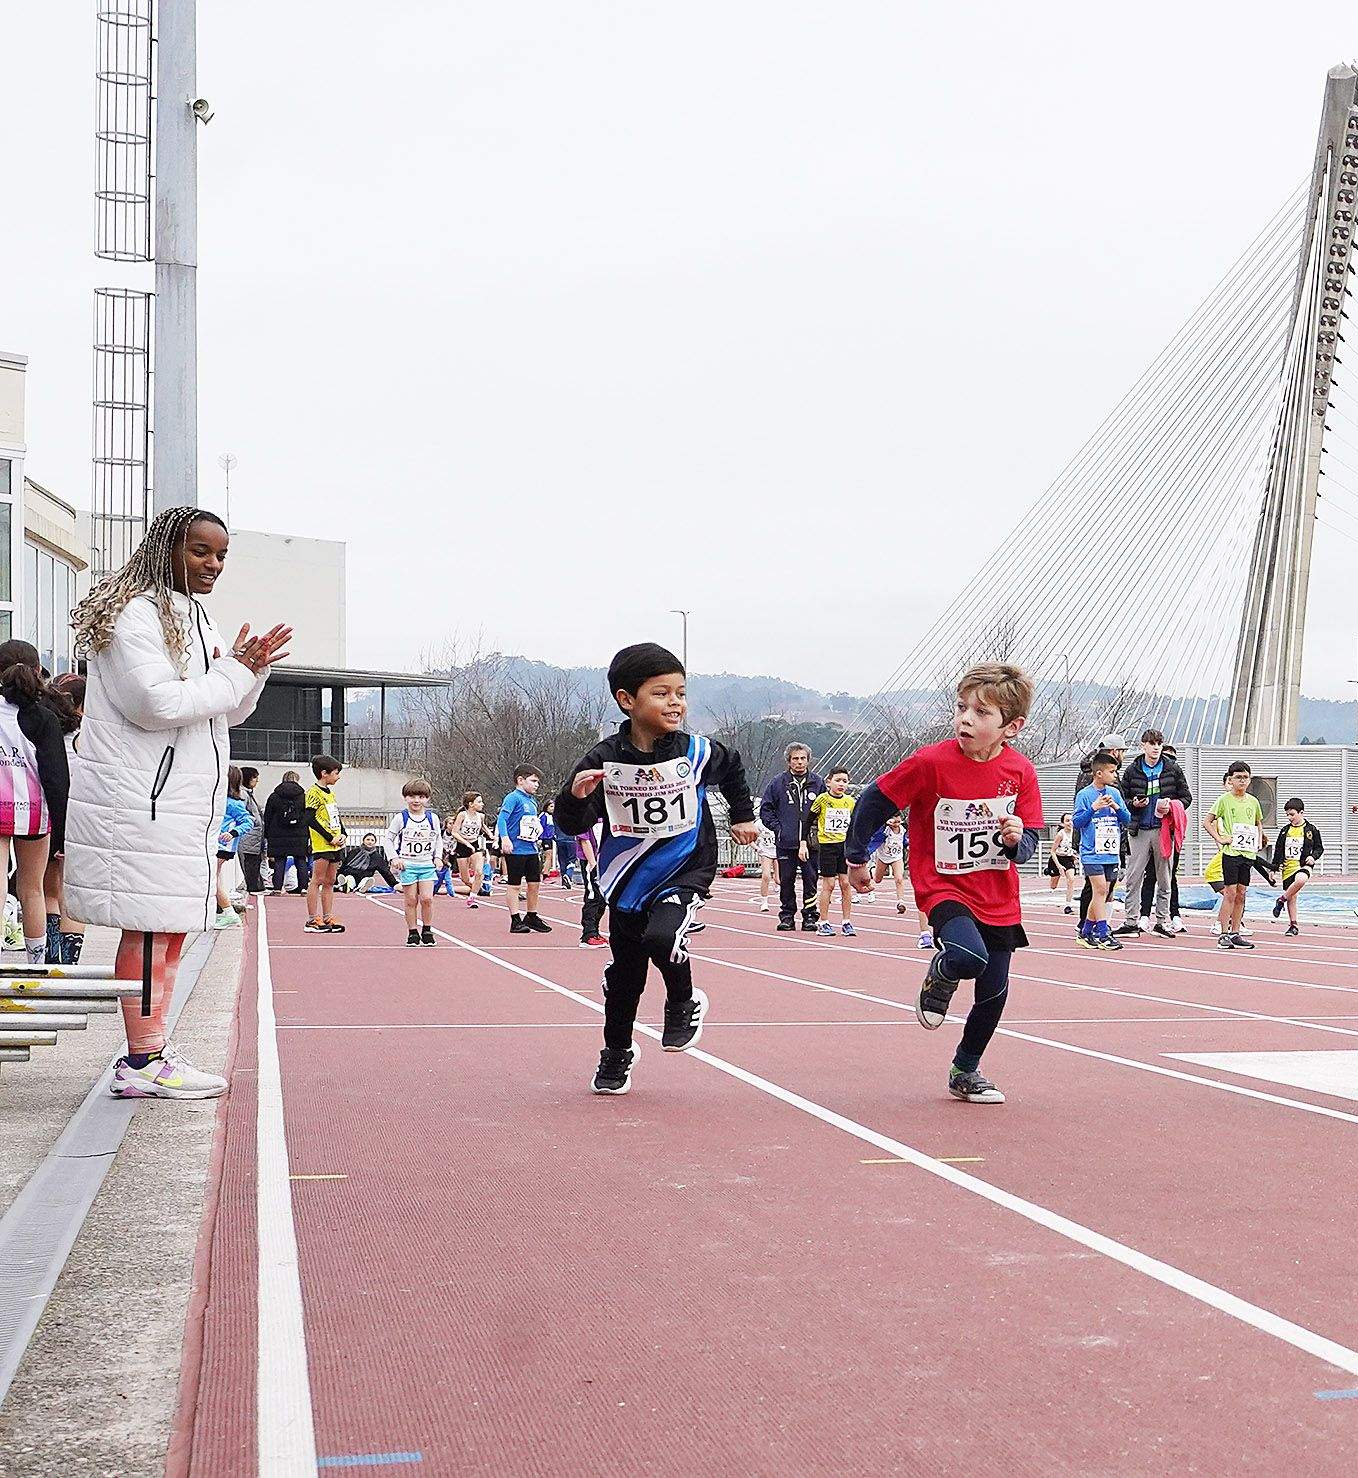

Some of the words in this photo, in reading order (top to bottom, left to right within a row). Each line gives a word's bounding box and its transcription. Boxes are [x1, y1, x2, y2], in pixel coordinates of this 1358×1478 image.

[660, 782, 675, 790] REIS
[605, 790, 624, 798] GRAN
[621, 792, 686, 825] 181
[830, 818, 850, 829] 125
[947, 830, 1006, 861] 159
[1103, 838, 1117, 849] 66
[1237, 834, 1255, 847] 241
[406, 842, 432, 854] 104
